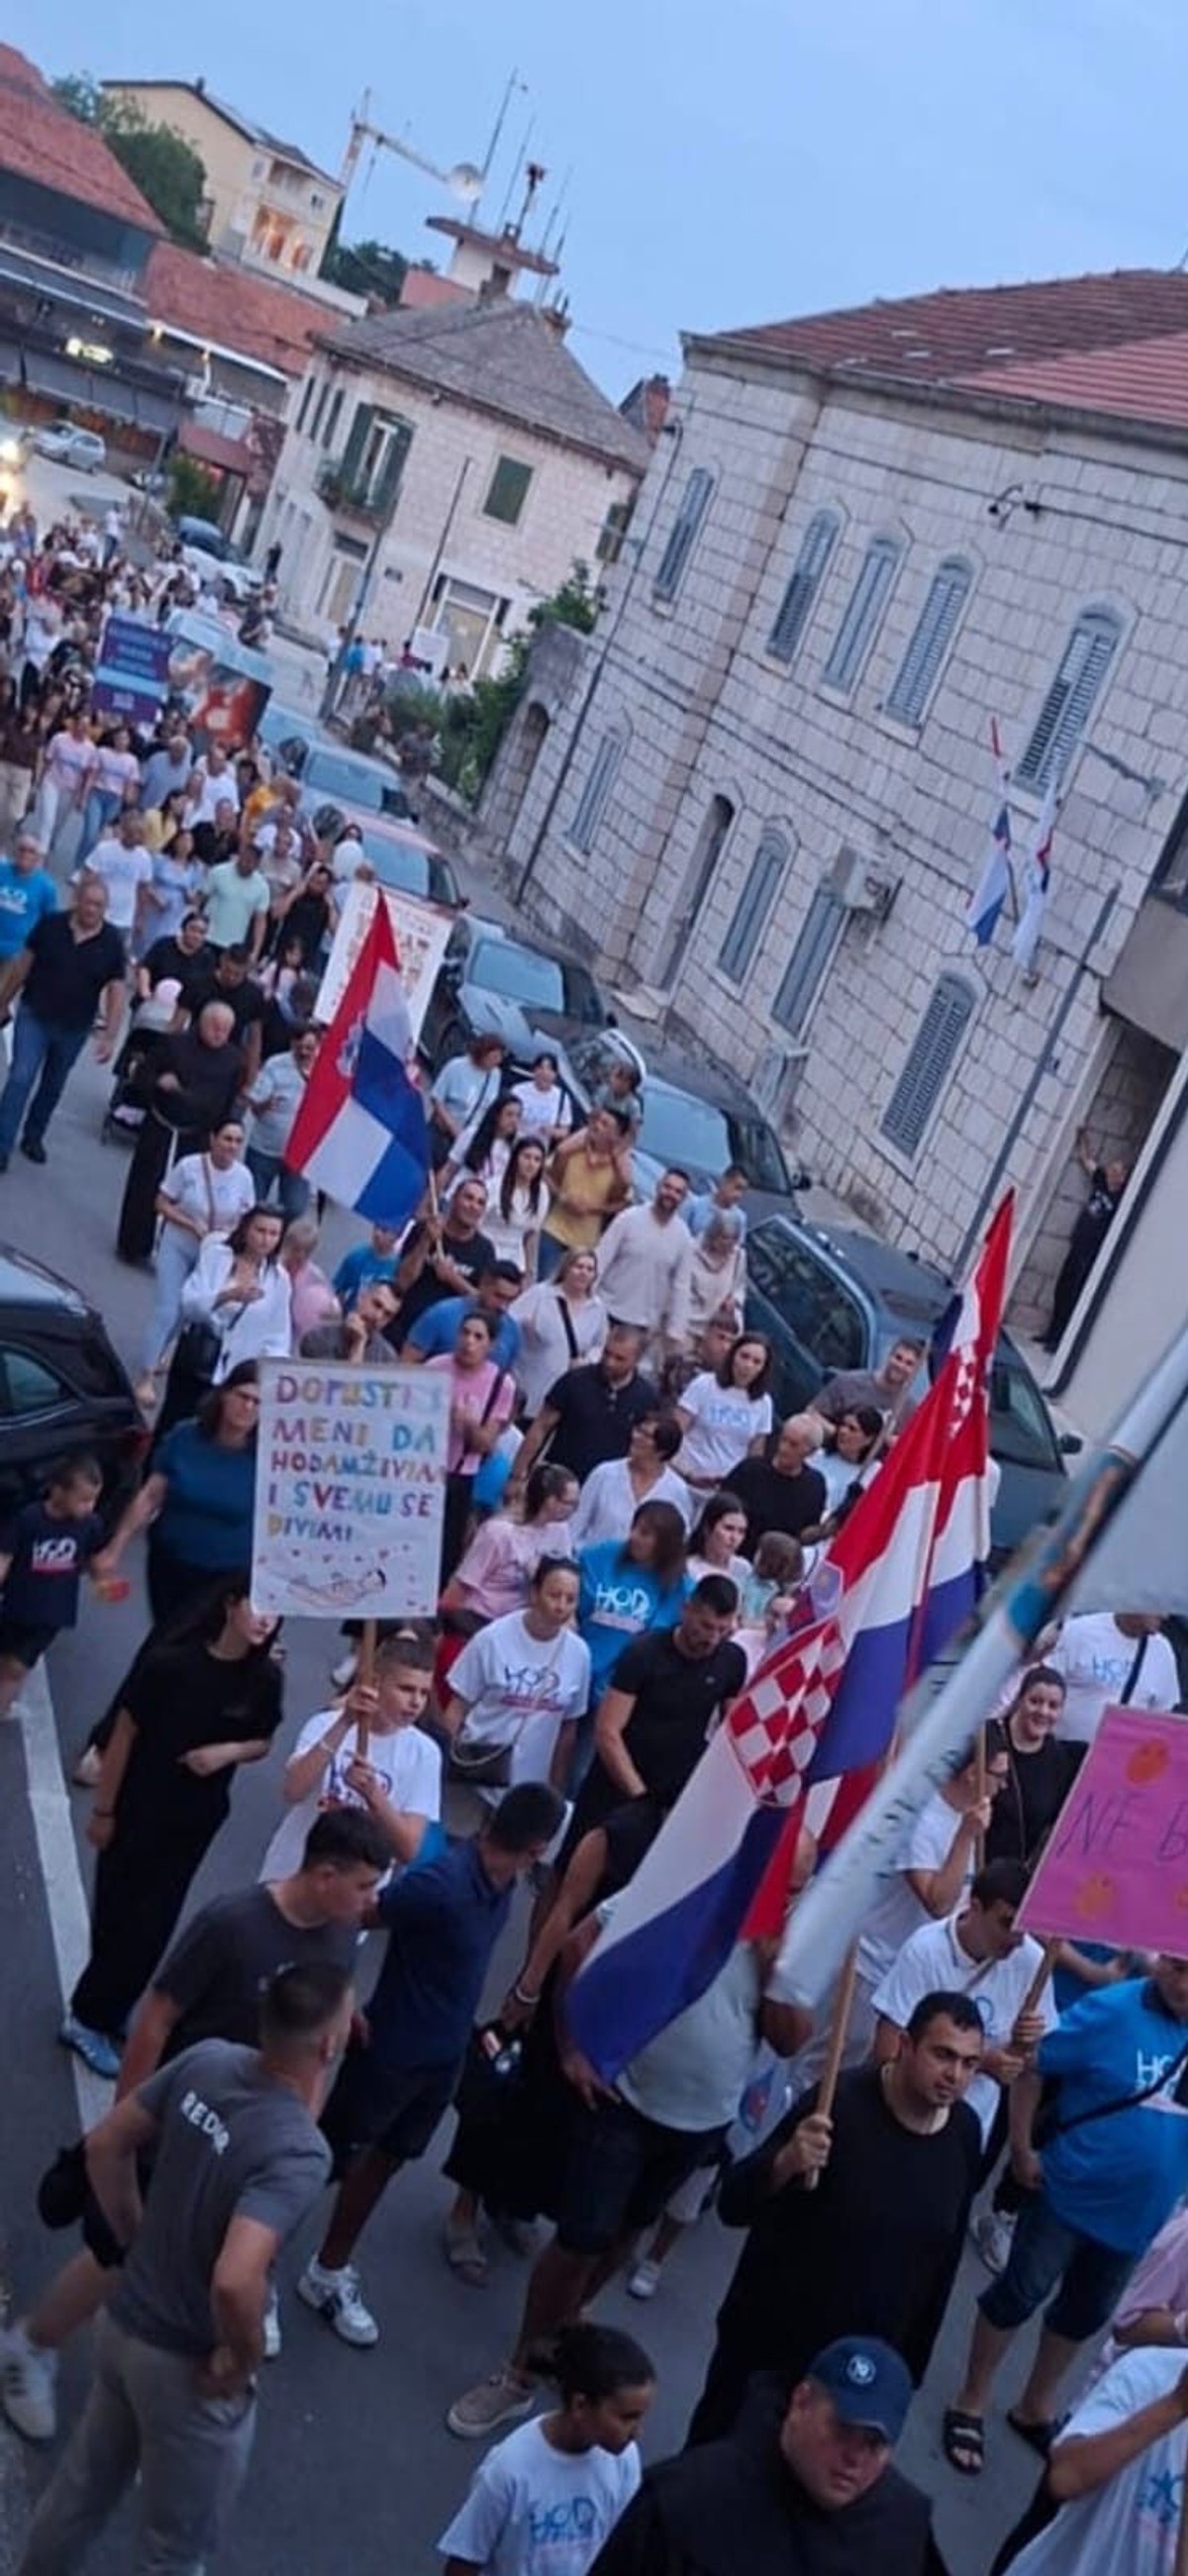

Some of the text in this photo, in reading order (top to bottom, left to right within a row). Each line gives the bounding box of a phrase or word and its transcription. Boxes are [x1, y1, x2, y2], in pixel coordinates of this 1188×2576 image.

[272, 1418, 436, 1453] MENI DA
[400, 1493, 435, 1518] SE
